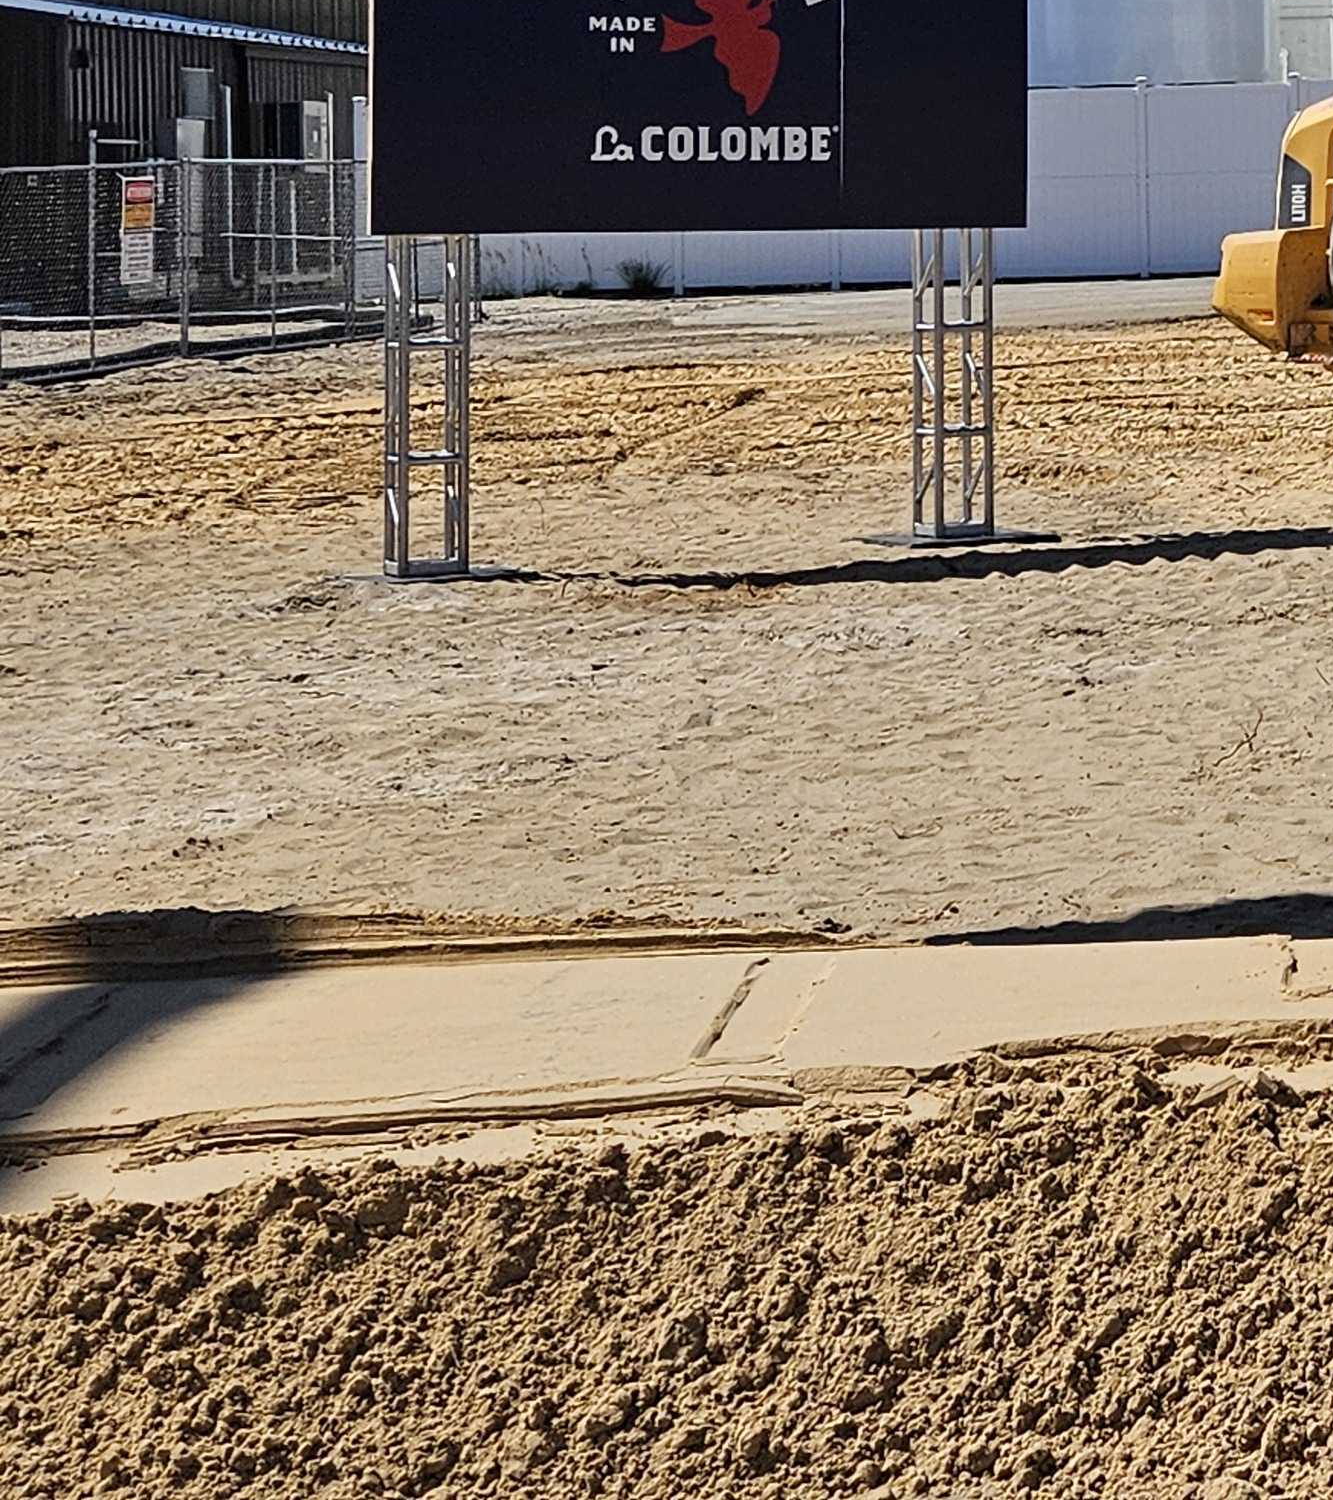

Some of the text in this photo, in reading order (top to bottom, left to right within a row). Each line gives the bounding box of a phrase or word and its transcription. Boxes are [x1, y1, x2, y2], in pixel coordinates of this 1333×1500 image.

[589, 16, 656, 32] MADE
[610, 37, 635, 52] IN
[590, 125, 832, 161] La COLOMBE
[1291, 184, 1306, 222] L110H
